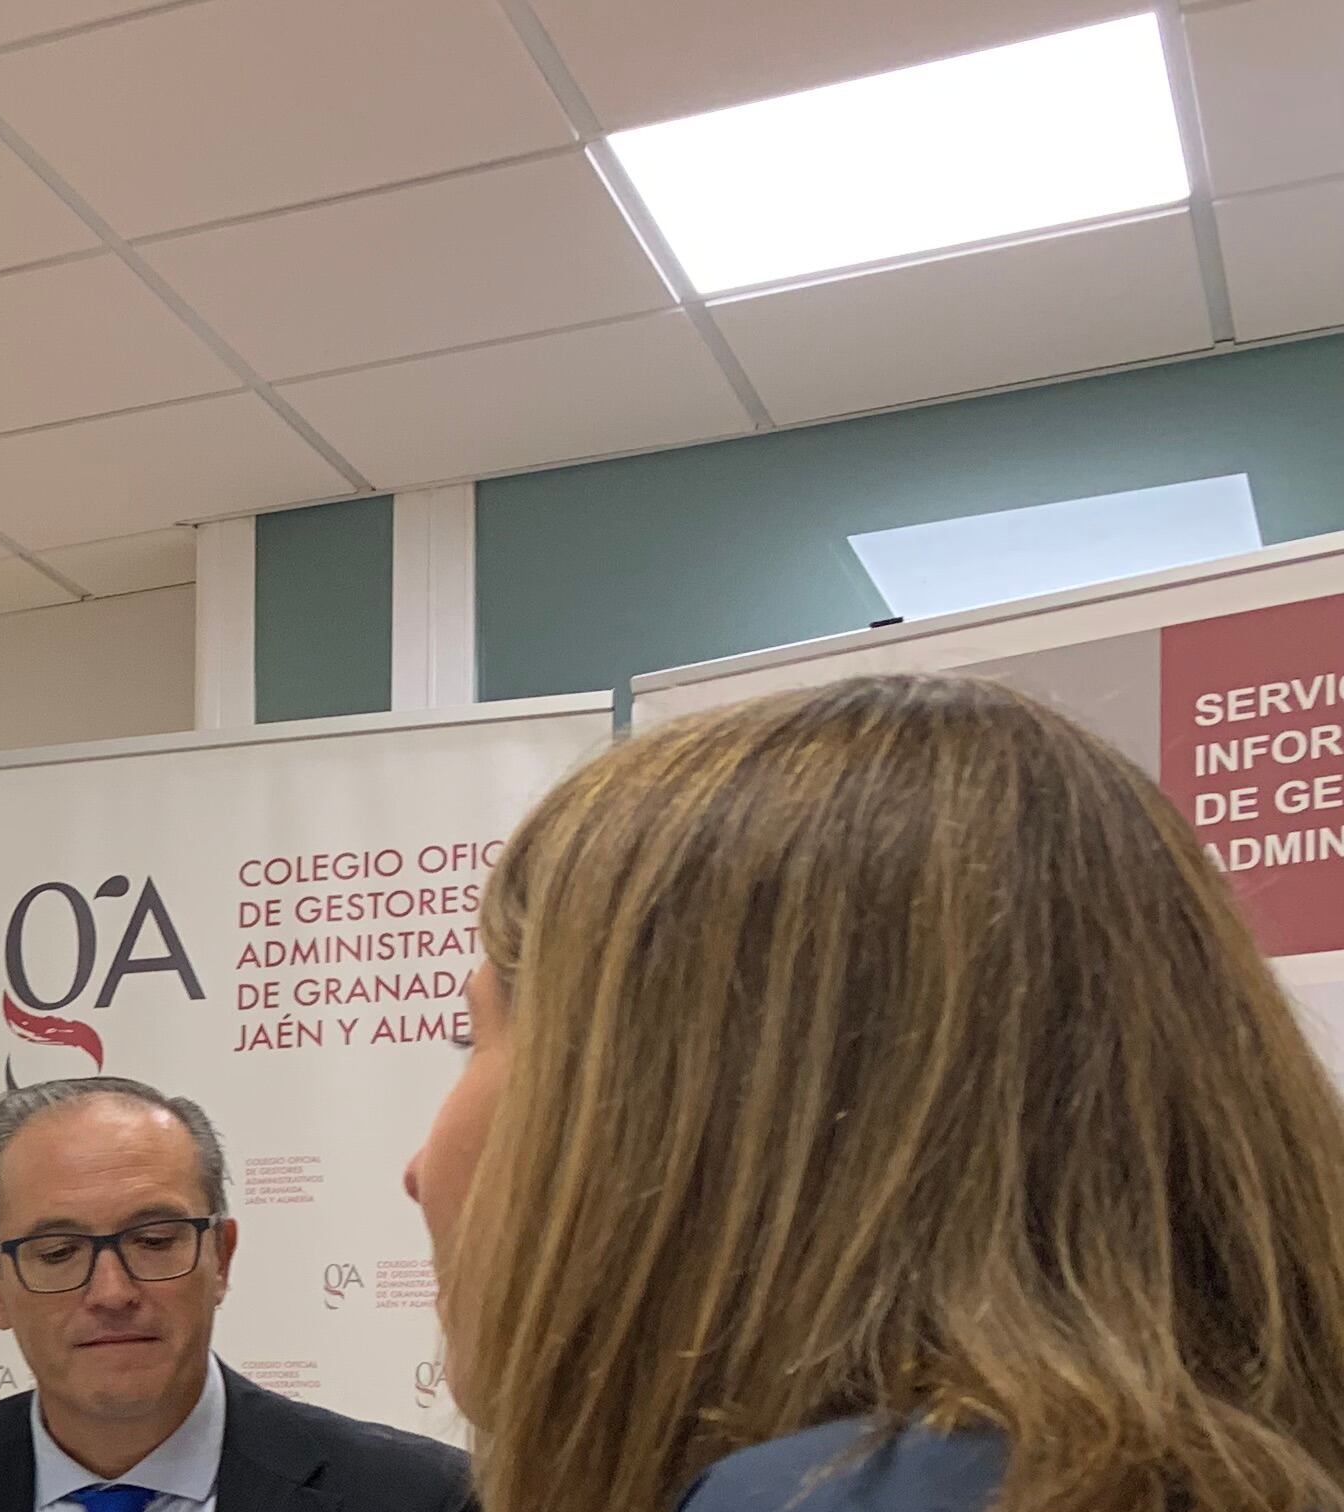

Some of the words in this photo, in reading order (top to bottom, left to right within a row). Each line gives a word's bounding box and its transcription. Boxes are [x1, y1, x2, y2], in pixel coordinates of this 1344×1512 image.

[1194, 673, 1344, 726] SERVI
[1195, 724, 1344, 777] INFOR
[1195, 786, 1259, 826] DE
[1274, 774, 1344, 814] GE
[239, 849, 403, 887] COLEGIO
[238, 900, 282, 928] DE
[295, 884, 481, 924] GESTORES
[235, 926, 480, 970] ADMINISTRAT
[237, 981, 280, 1010] DE
[234, 1013, 323, 1052] JAÉN
[337, 1017, 359, 1045] Y
[371, 1011, 470, 1045] ALME
